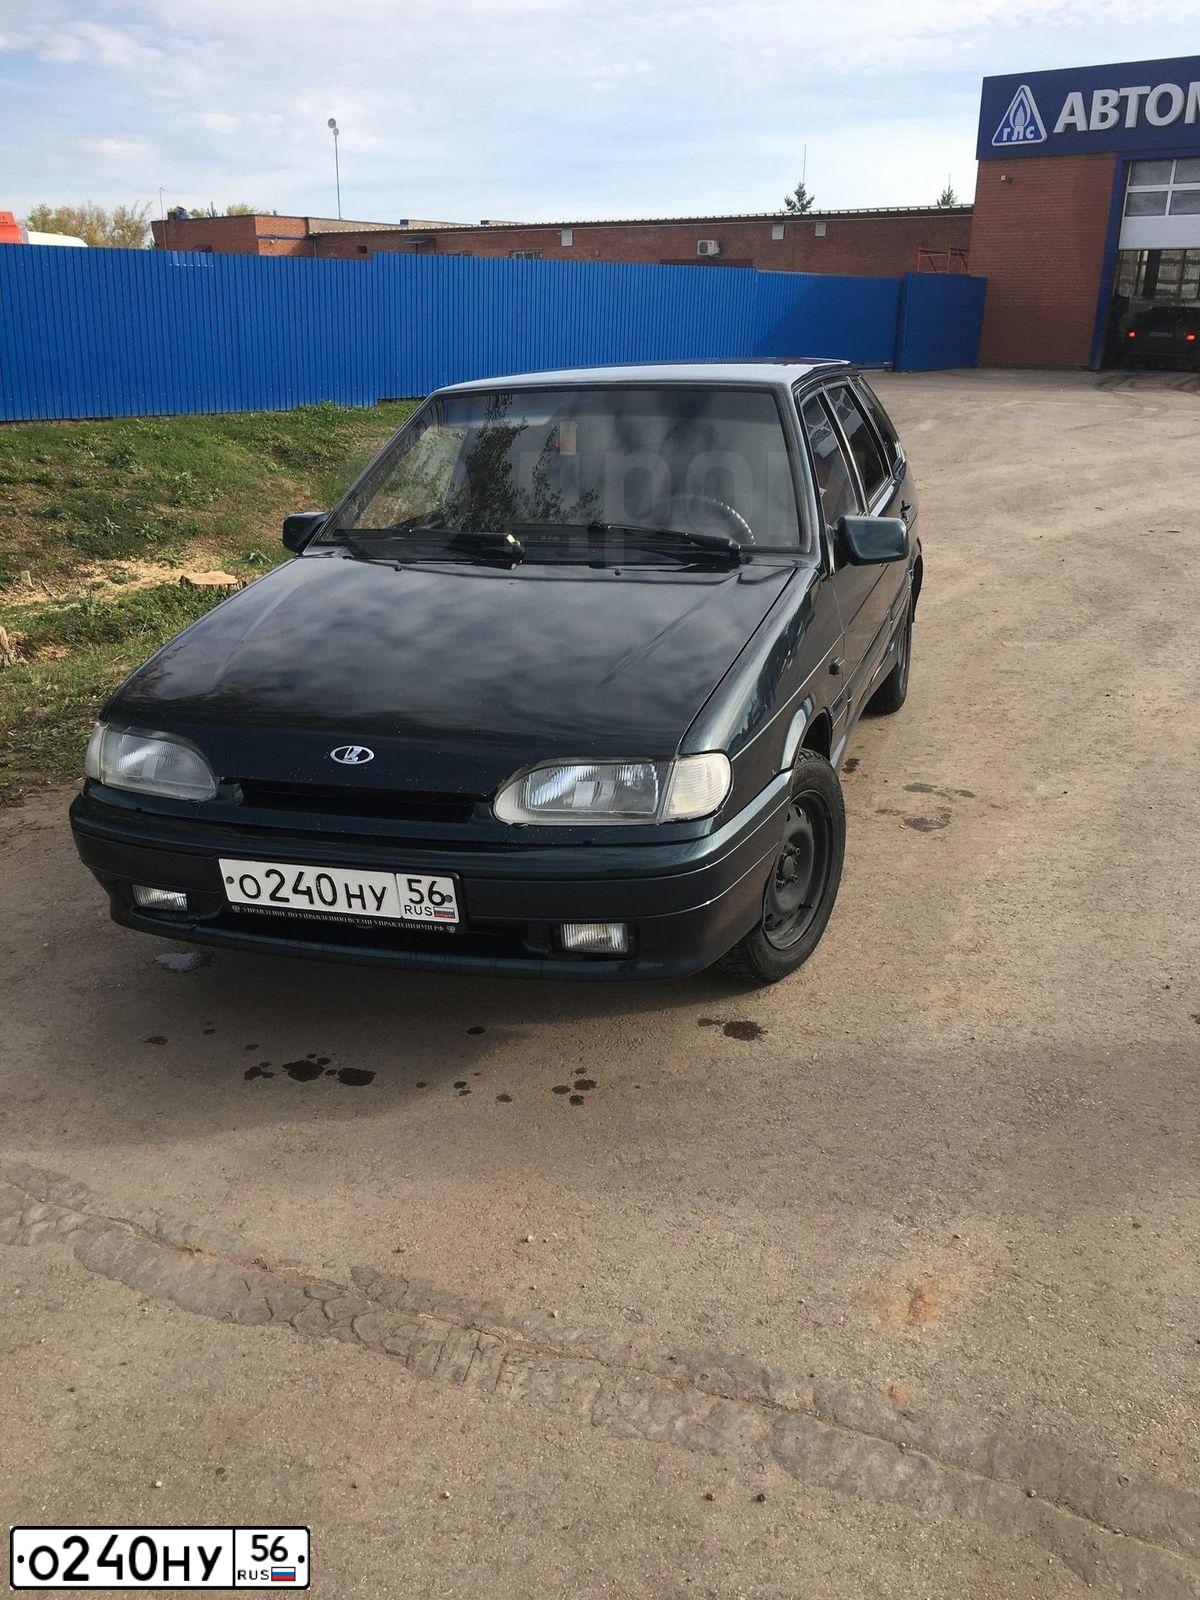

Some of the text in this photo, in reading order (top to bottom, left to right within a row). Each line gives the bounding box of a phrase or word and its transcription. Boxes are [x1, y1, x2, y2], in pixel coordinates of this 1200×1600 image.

[239, 868, 446, 912] О240НУ 56
[404, 905, 433, 917] RUS
